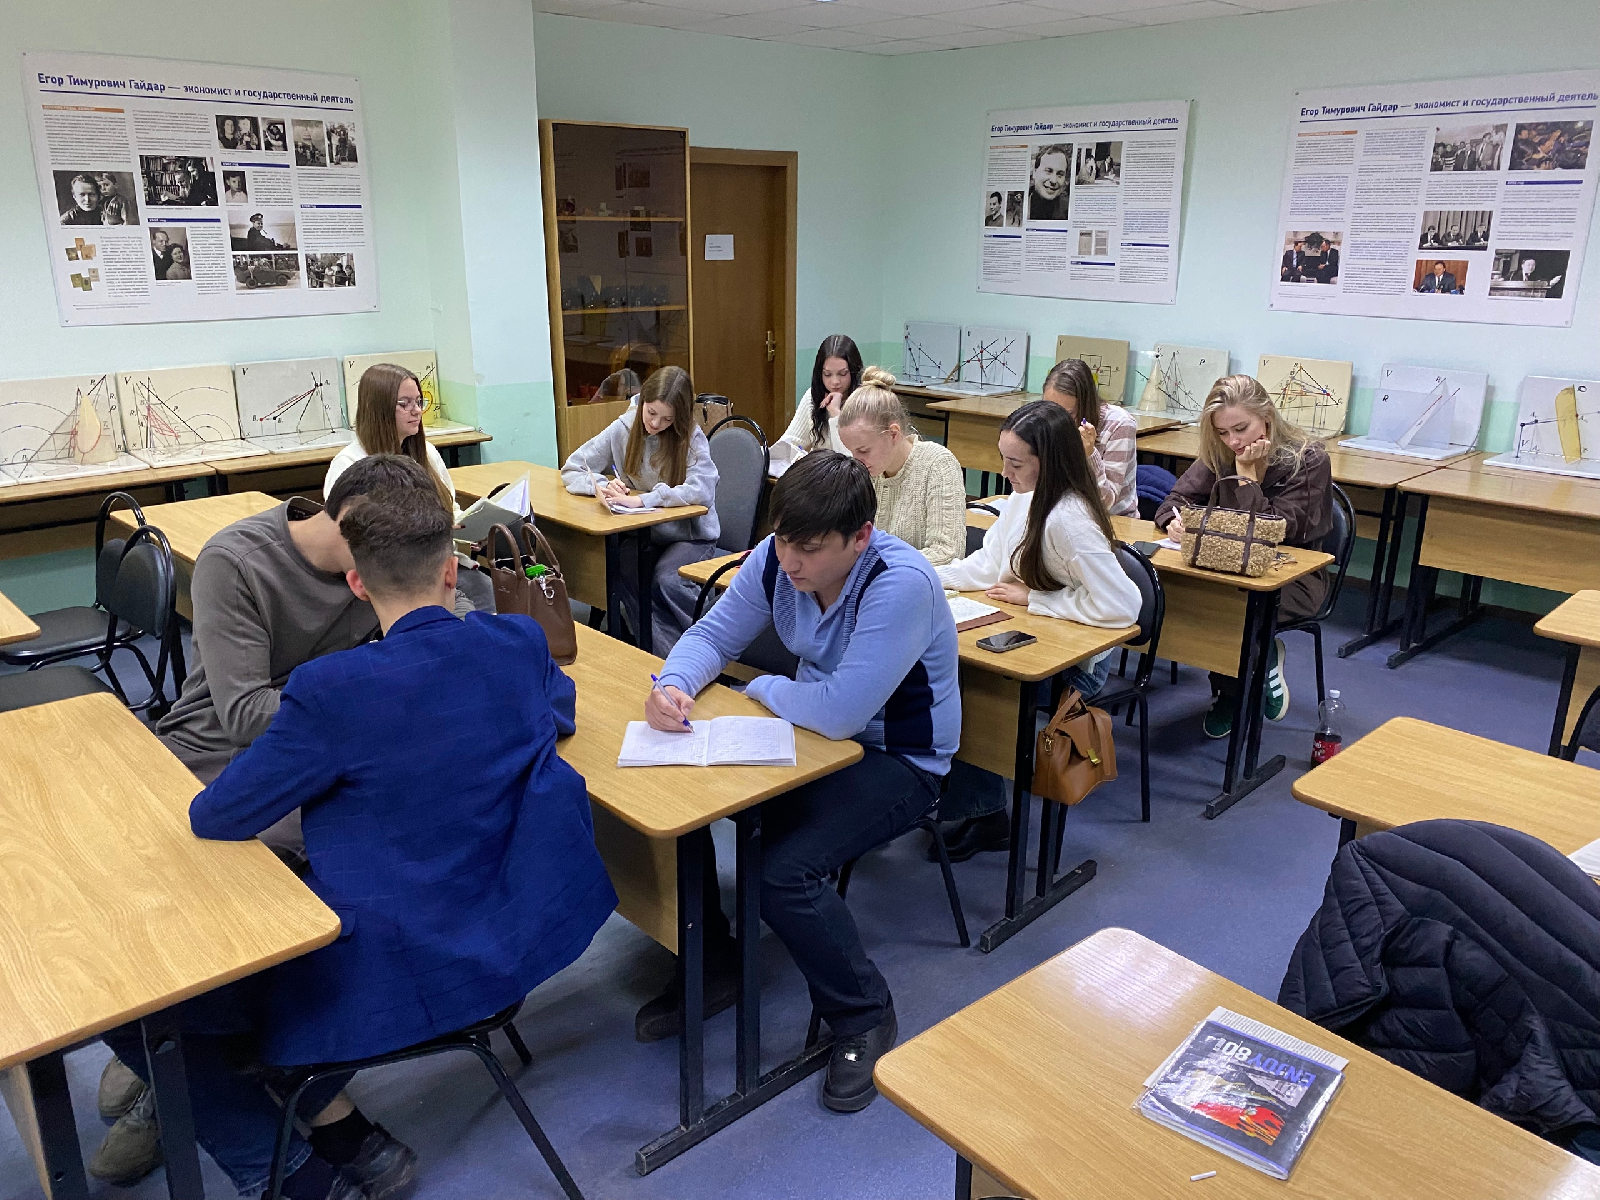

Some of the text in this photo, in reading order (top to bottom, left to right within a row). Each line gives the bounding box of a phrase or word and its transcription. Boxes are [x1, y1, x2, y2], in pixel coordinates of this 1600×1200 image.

[37, 73, 64, 87] Егор
[65, 74, 126, 90] Тимурович
[128, 78, 166, 93] Гайдар
[183, 84, 232, 96] экономист
[234, 88, 241, 96] и
[242, 88, 319, 104] государственный
[320, 94, 354, 105] деятель
[1300, 106, 1319, 118] Егор
[1321, 104, 1366, 118] Тимурович
[1367, 101, 1398, 115] Гайдар
[1413, 99, 1461, 110] экономист
[1462, 98, 1469, 107] и
[1470, 92, 1556, 107] государственный
[1557, 90, 1599, 103] деятель
[1247, 1052, 1316, 1086] ENJOY
